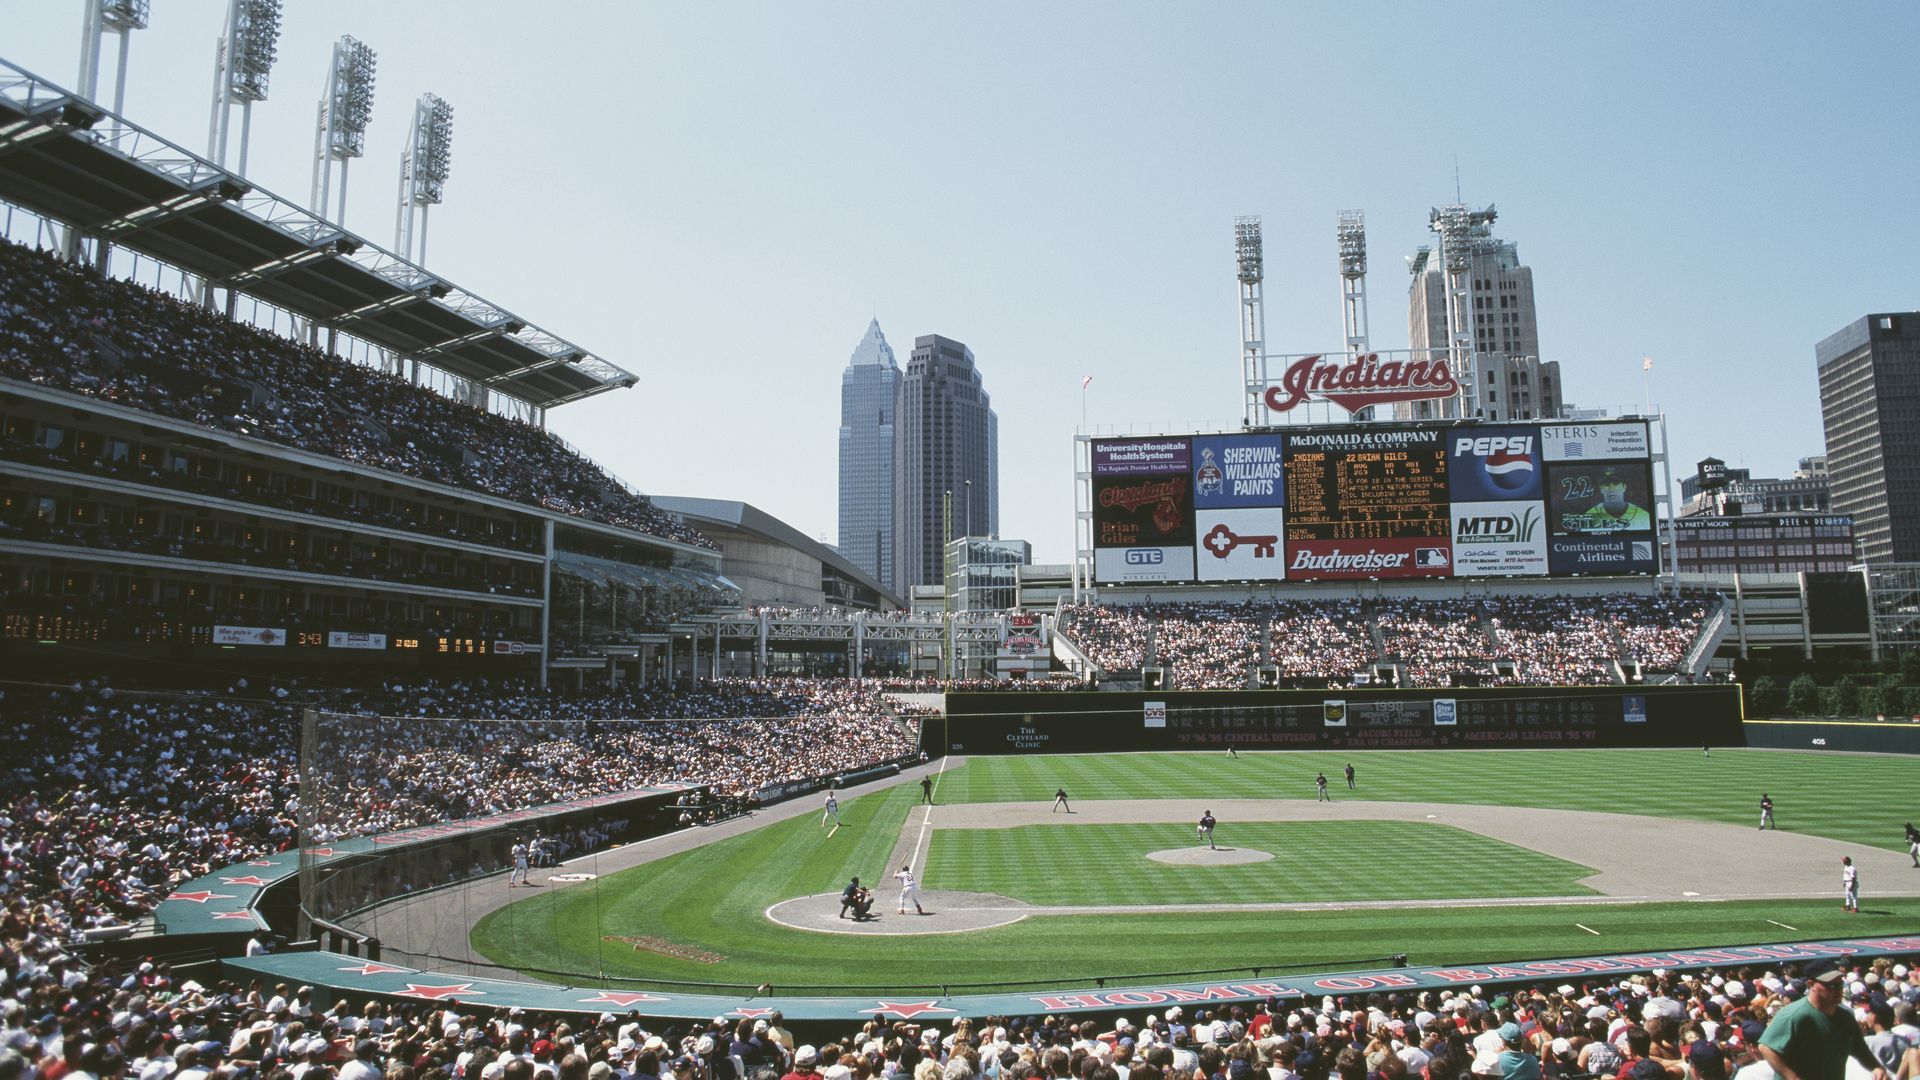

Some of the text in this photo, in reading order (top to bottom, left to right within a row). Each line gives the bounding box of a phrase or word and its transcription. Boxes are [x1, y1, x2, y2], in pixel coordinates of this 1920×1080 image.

[1264, 353, 1458, 413] Indians
[1290, 432, 1438, 446] McDONALD & COMPANY
[1544, 427, 1598, 439] STERIS
[1321, 442, 1408, 450] INVESTMENTS
[1454, 436, 1534, 456] PEPSI
[1608, 436, 1642, 444] Prevention
[1224, 447, 1280, 464] SHERWIN-
[1294, 454, 1325, 462] INDIANS
[1358, 453, 1380, 462] BRIAN
[1384, 452, 1408, 460] GILES
[1435, 450, 1445, 460] LF
[1226, 463, 1280, 480] WILLIAMS
[1234, 479, 1274, 496] PAINTS
[1562, 476, 1594, 500] 22
[1102, 521, 1140, 532] Brian
[1458, 517, 1514, 534] MTD
[1102, 532, 1136, 544] Giles
[1554, 542, 1624, 552] Continental
[1128, 551, 1162, 562] GTE
[1290, 549, 1409, 570] Budweiser
[1578, 553, 1625, 562] Airlines
[1145, 708, 1164, 716] CVS
[1376, 702, 1403, 712] 1998
[1225, 733, 1263, 742] CENTRAL
[1265, 732, 1316, 742] DIVISION
[1464, 731, 1518, 741] AMERICAN
[1522, 730, 1562, 740] LEAGUE
[1030, 982, 1301, 1010] HOME
[1314, 972, 1418, 991] OF
[1420, 943, 1858, 983] BASEBALL'S
